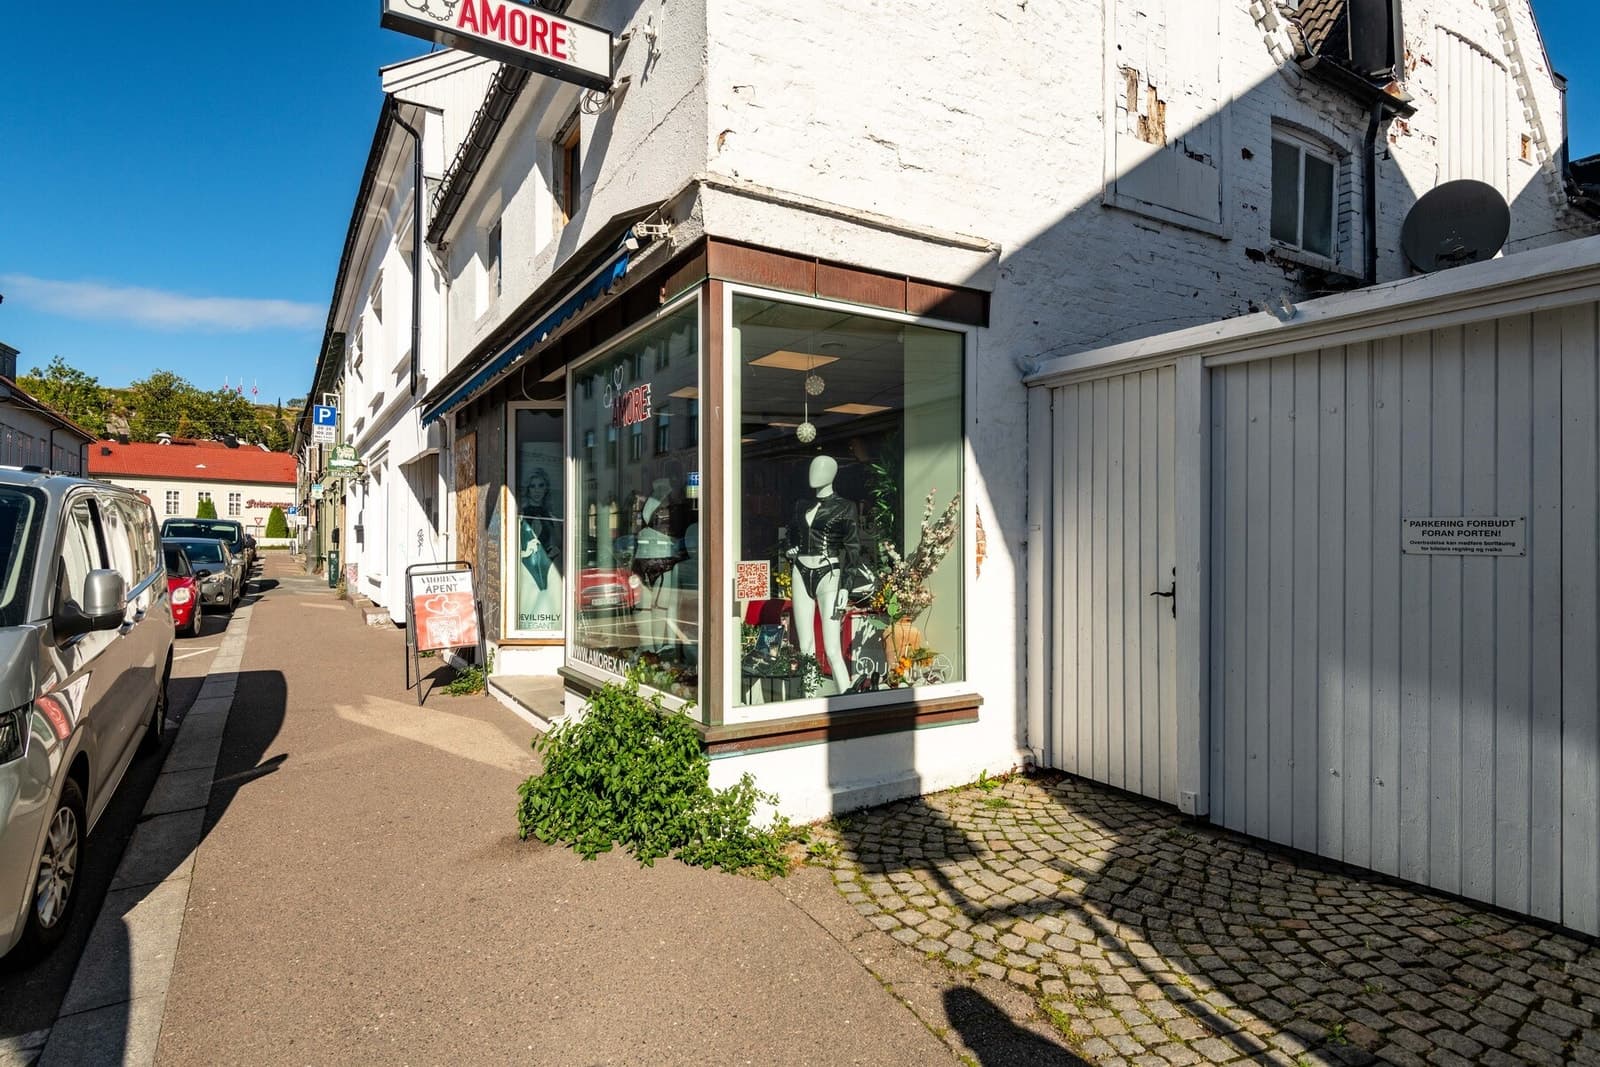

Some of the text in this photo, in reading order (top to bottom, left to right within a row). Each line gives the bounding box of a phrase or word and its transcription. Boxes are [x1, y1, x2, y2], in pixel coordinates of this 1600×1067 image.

[456, 0, 567, 59] AMORE
[612, 384, 647, 427] AMORE
[319, 407, 332, 424] P
[1409, 520, 1516, 528] PARKERING FORBUDT
[1421, 529, 1502, 537] FORAN PORTEN!
